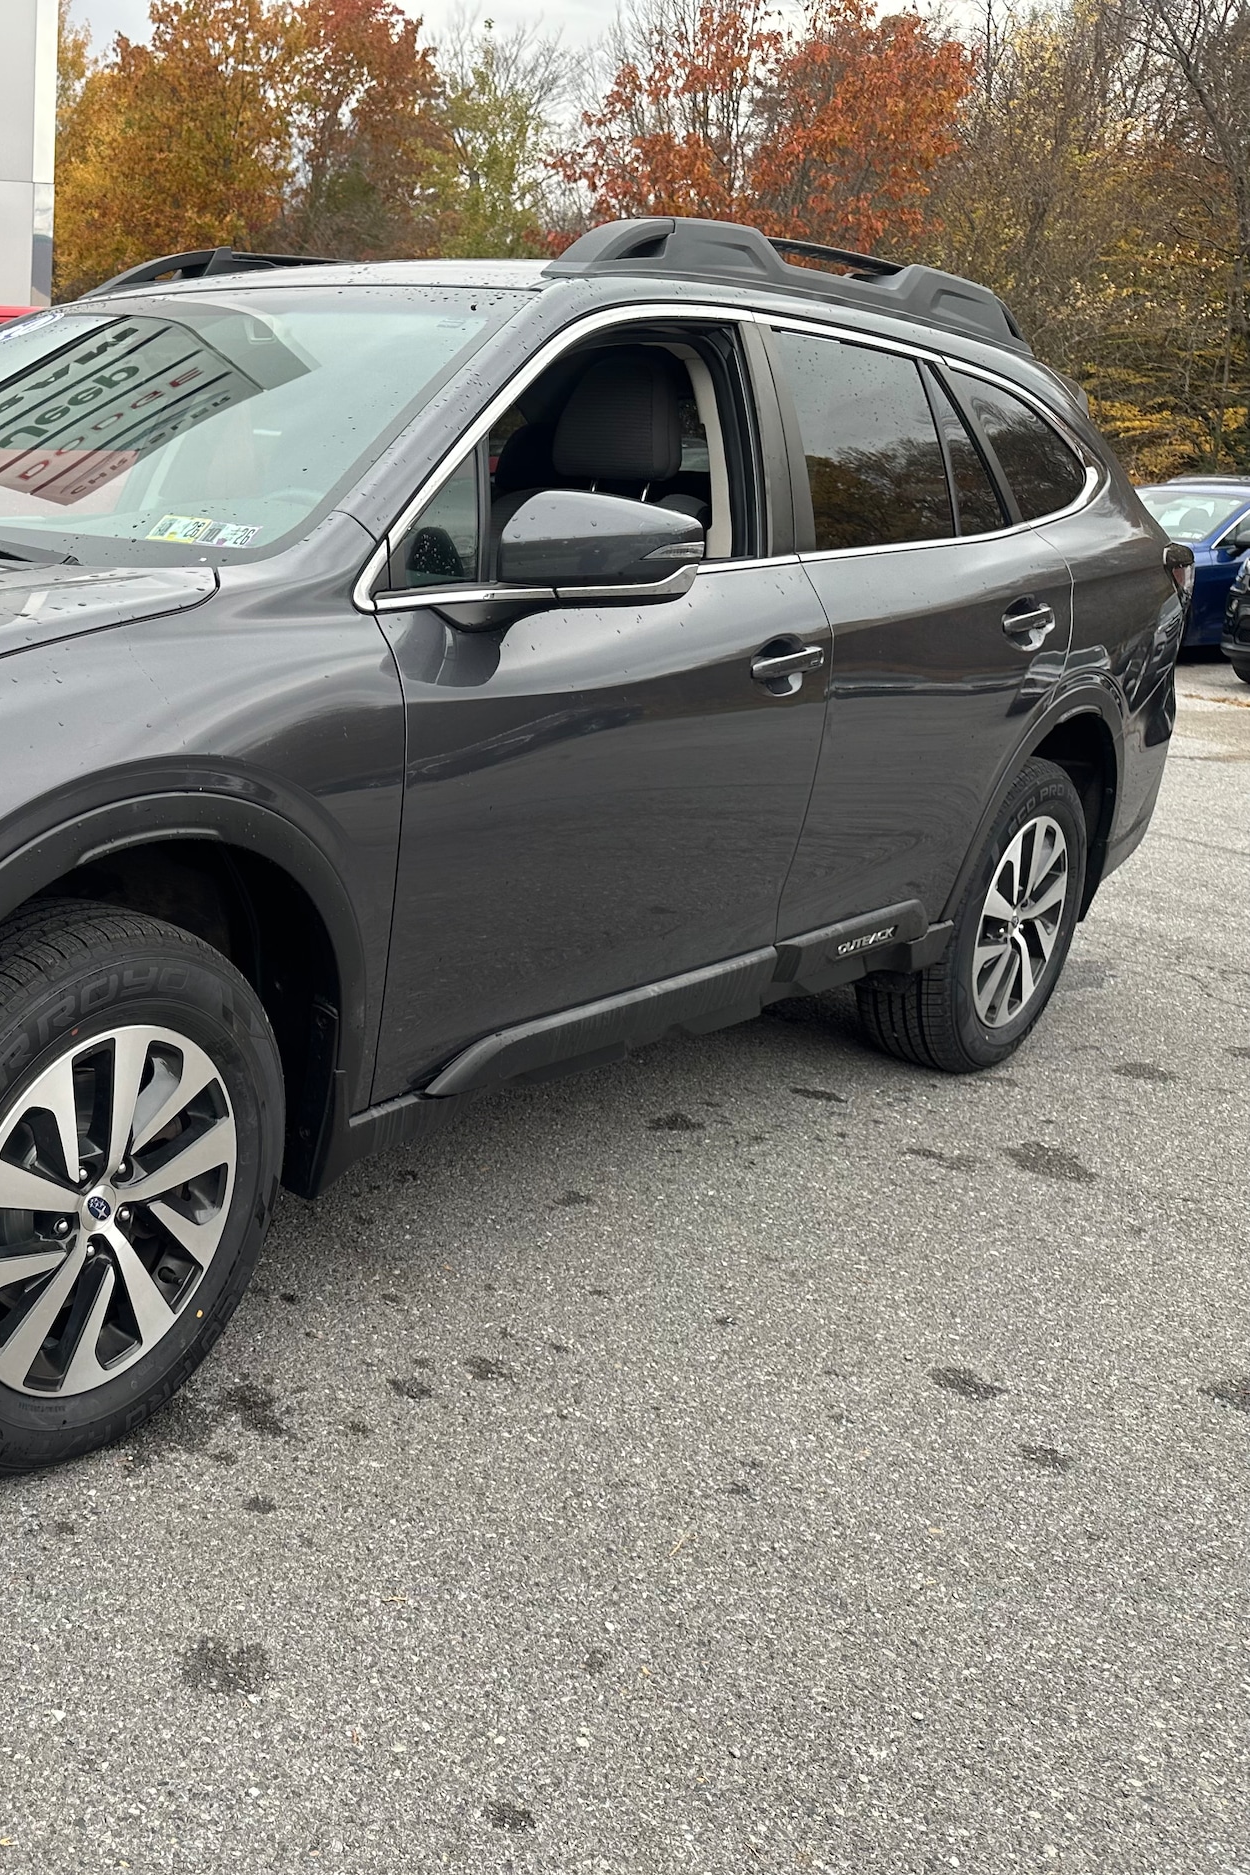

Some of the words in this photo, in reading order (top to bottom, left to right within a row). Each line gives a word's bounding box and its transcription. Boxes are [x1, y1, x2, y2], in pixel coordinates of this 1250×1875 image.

[233, 527, 256, 546] 26
[1040, 784, 1065, 801] PRO
[837, 926, 896, 955] OUTBACK
